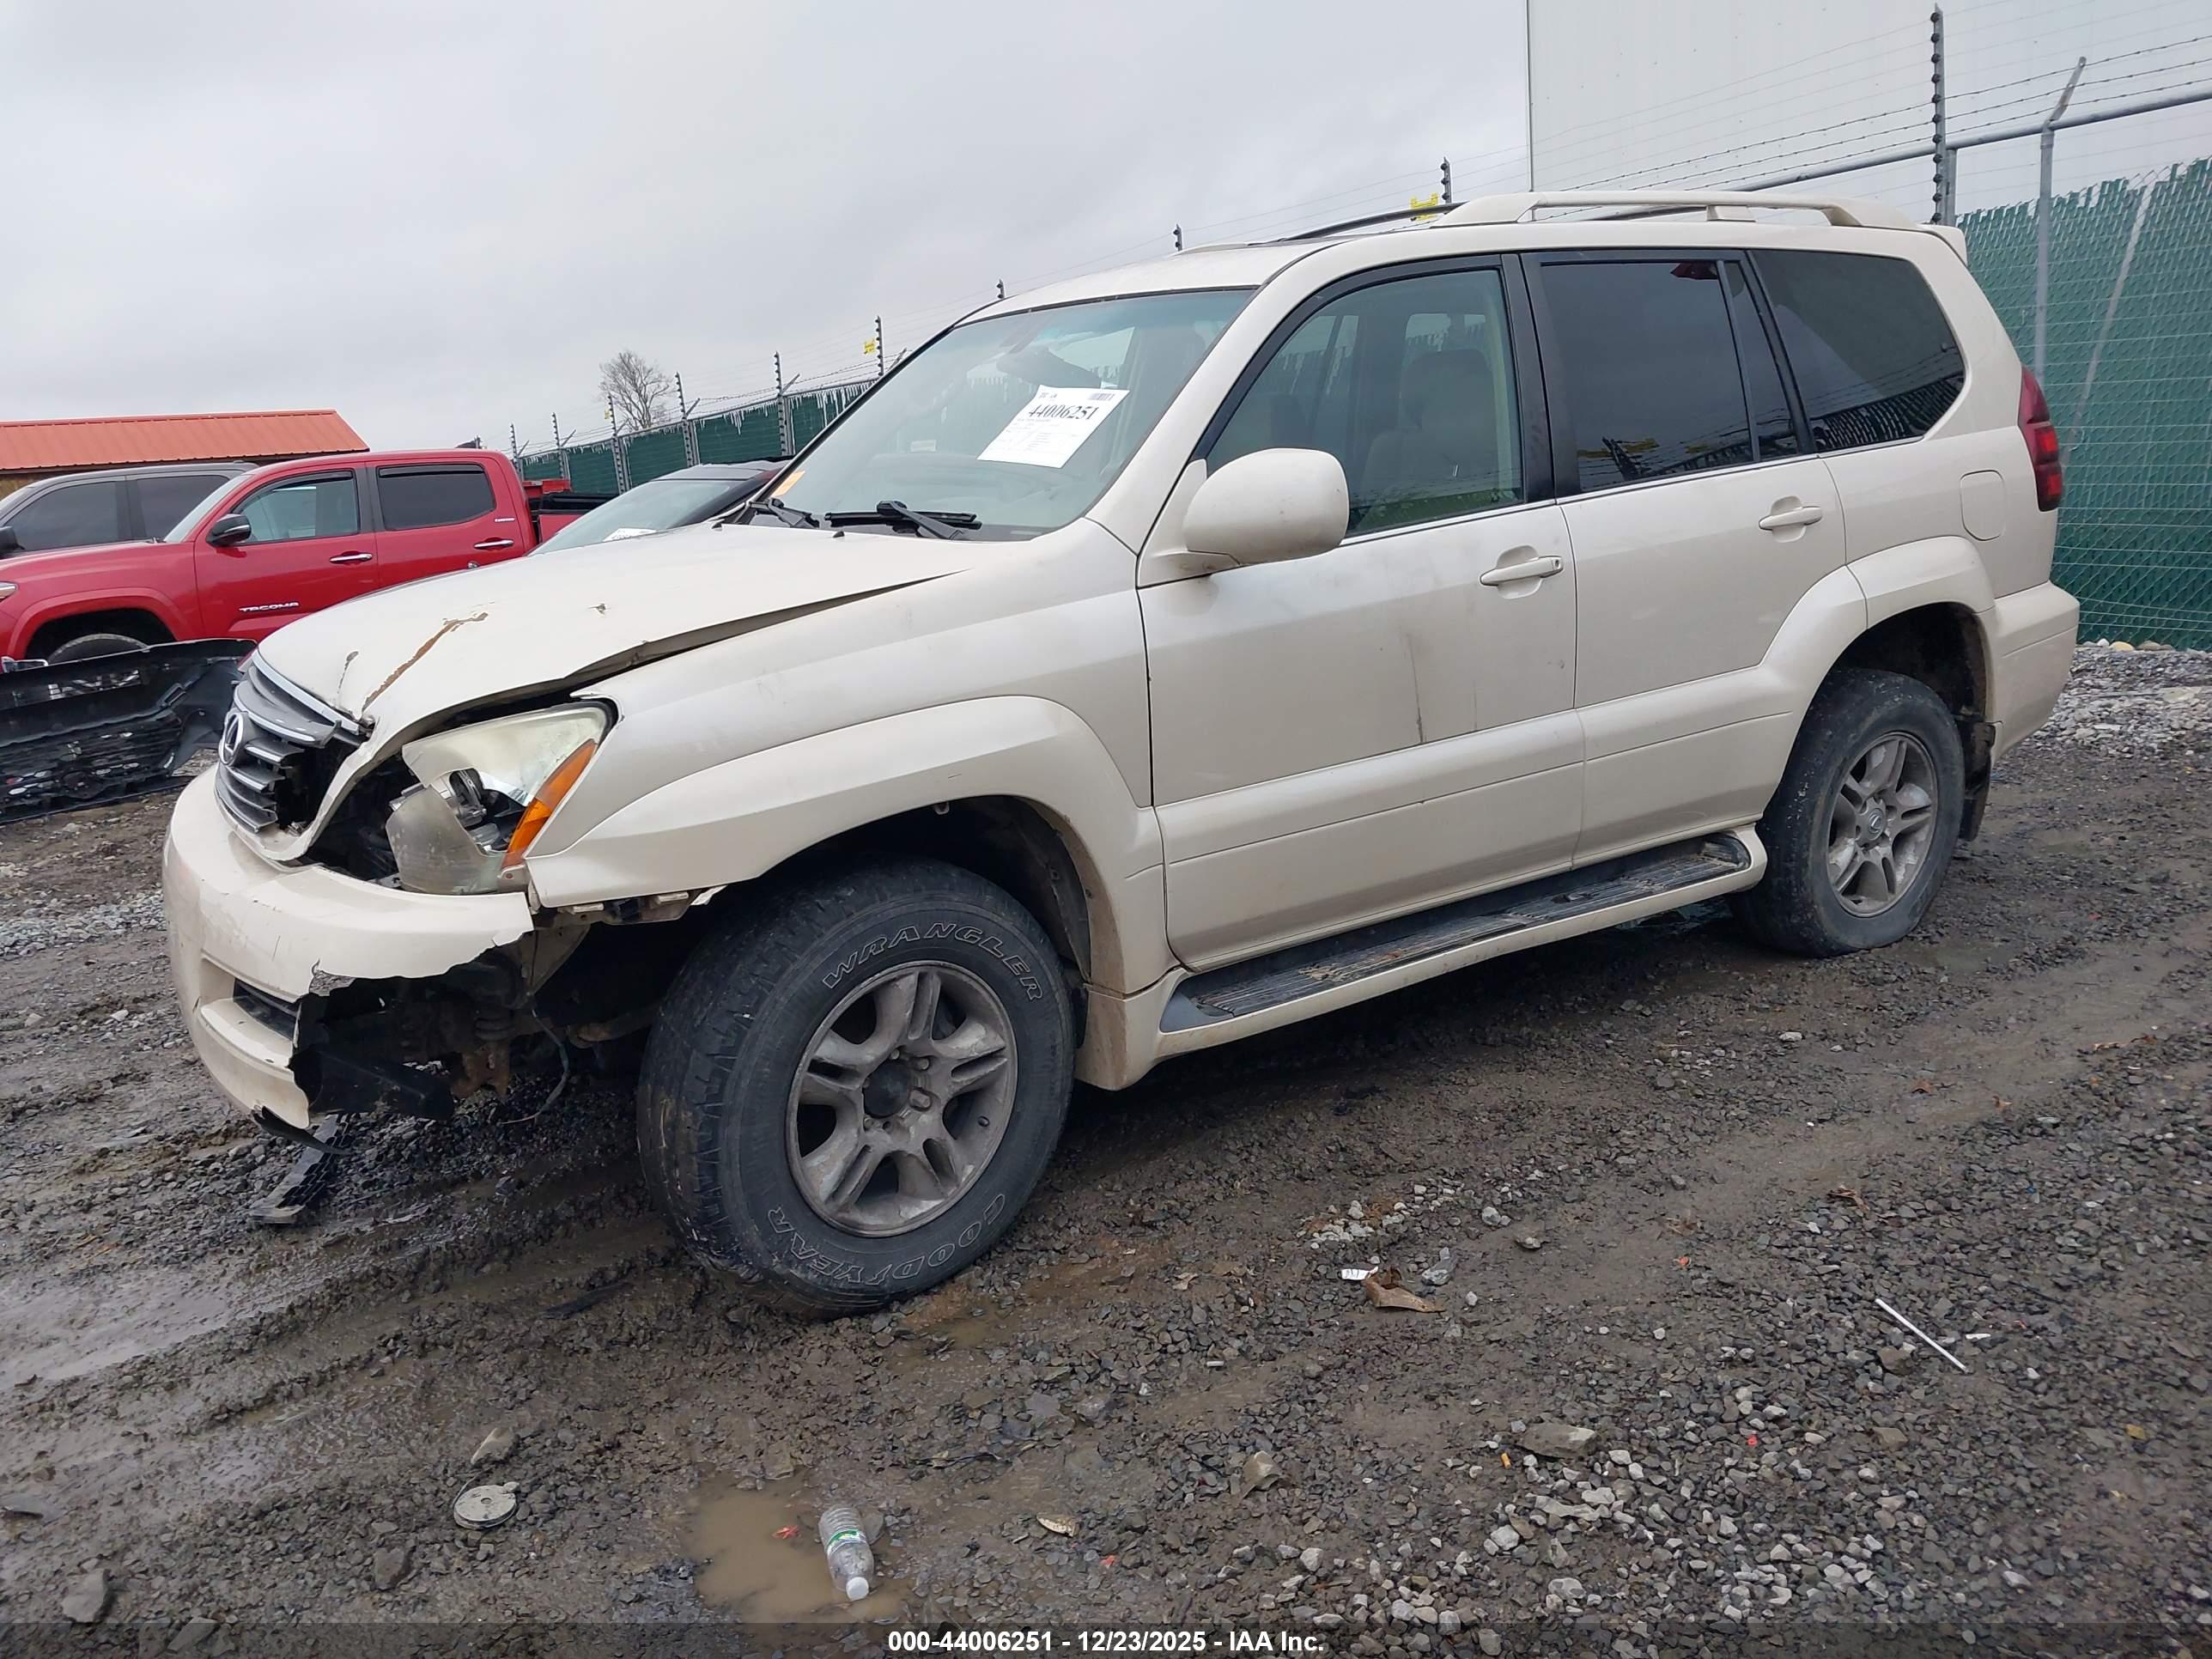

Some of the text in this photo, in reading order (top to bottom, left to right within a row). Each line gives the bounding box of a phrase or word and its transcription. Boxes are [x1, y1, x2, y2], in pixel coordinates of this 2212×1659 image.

[1028, 404, 1099, 420] 44006251
[238, 602, 300, 612] TACOMA
[822, 921, 1043, 1002] WRANGLER
[767, 1193, 1006, 1285] GOODYEAR
